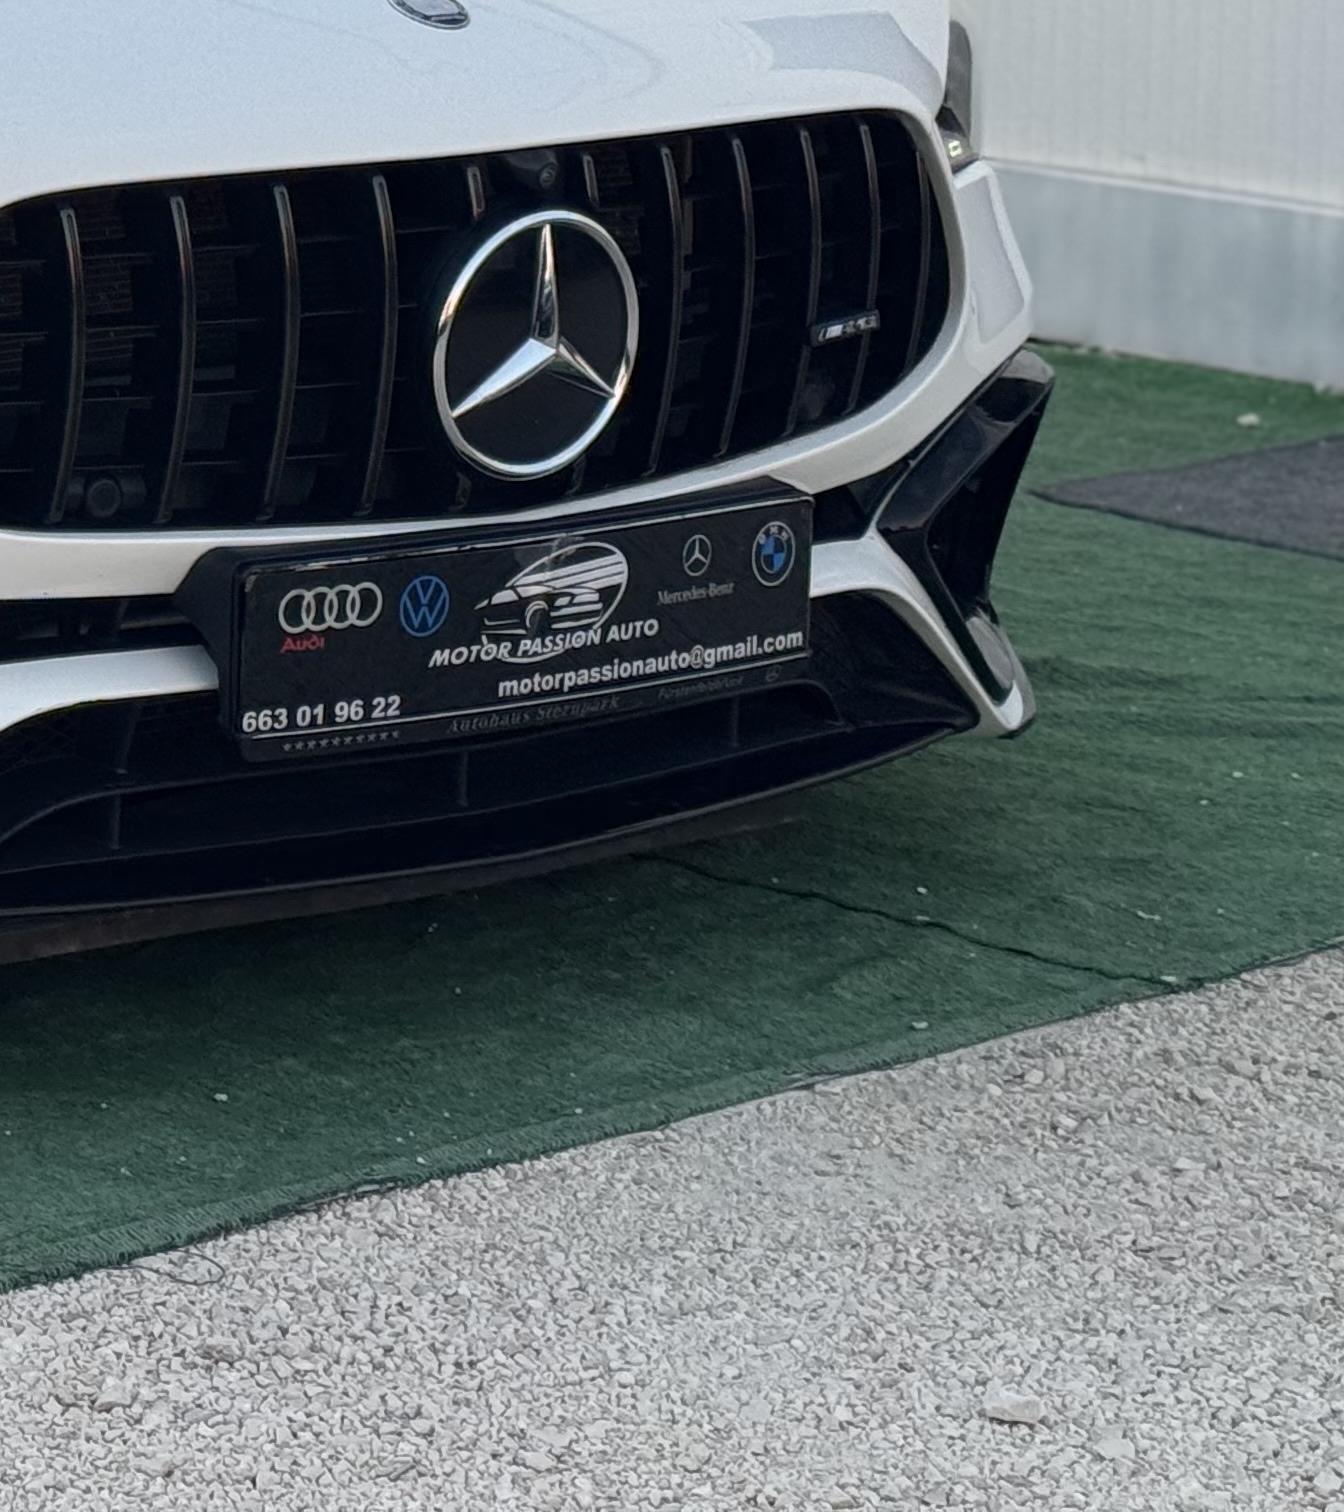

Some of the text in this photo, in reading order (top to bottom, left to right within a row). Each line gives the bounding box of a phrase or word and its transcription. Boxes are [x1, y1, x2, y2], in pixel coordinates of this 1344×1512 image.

[280, 634, 325, 653] Audi
[428, 618, 659, 668] MOTOR PASSION AUTO
[497, 628, 803, 697] motorpassionauto@gmail.com
[242, 695, 401, 732] 663 01 96 22
